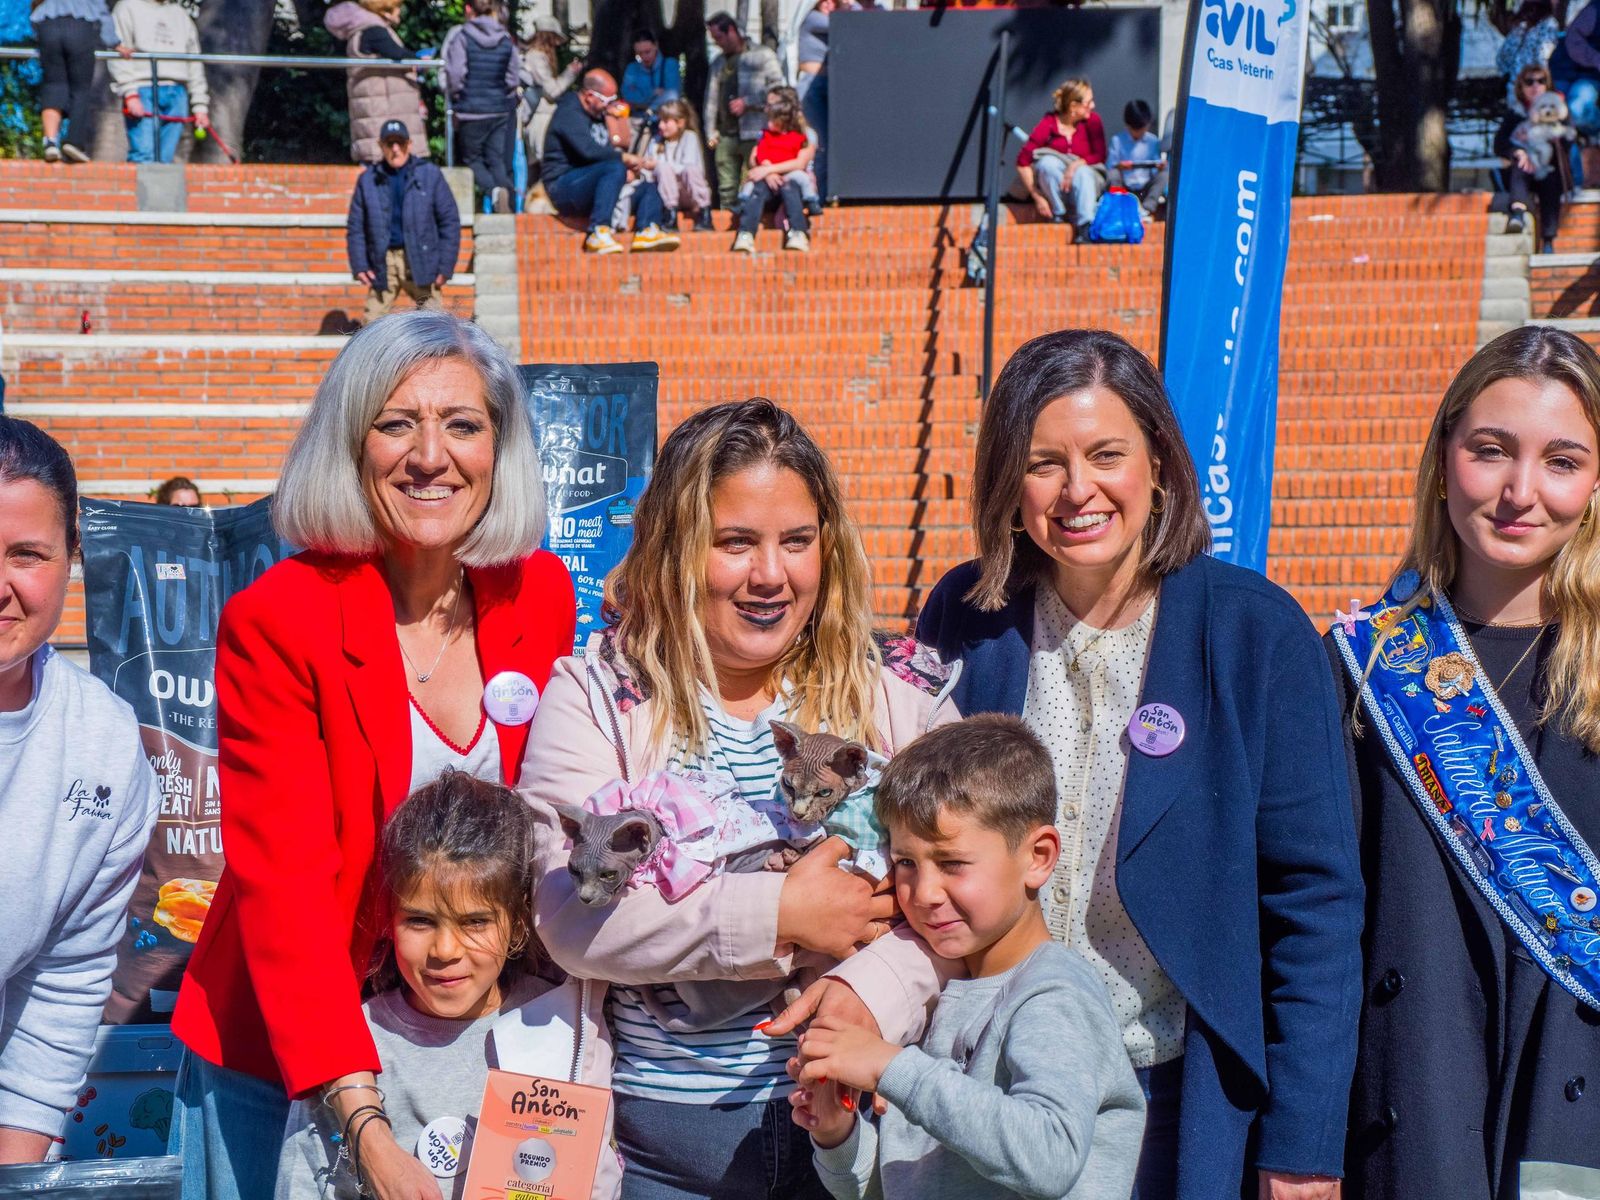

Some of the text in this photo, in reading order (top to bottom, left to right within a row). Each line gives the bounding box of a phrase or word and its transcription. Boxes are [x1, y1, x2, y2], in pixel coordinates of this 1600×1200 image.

[549, 516, 576, 538] NO
[577, 574, 594, 586] 60%
[1138, 709, 1178, 734] Antón
[1150, 705, 1169, 719] San
[150, 749, 182, 777] only
[158, 774, 193, 796] RESH
[160, 793, 192, 816] EAT
[166, 827, 223, 855] NATU
[530, 1079, 559, 1098] San
[511, 1091, 578, 1120] Antón
[519, 1152, 551, 1163] SEGUNDO
[520, 1158, 547, 1168] PREMIO
[507, 1179, 551, 1194] categoría
